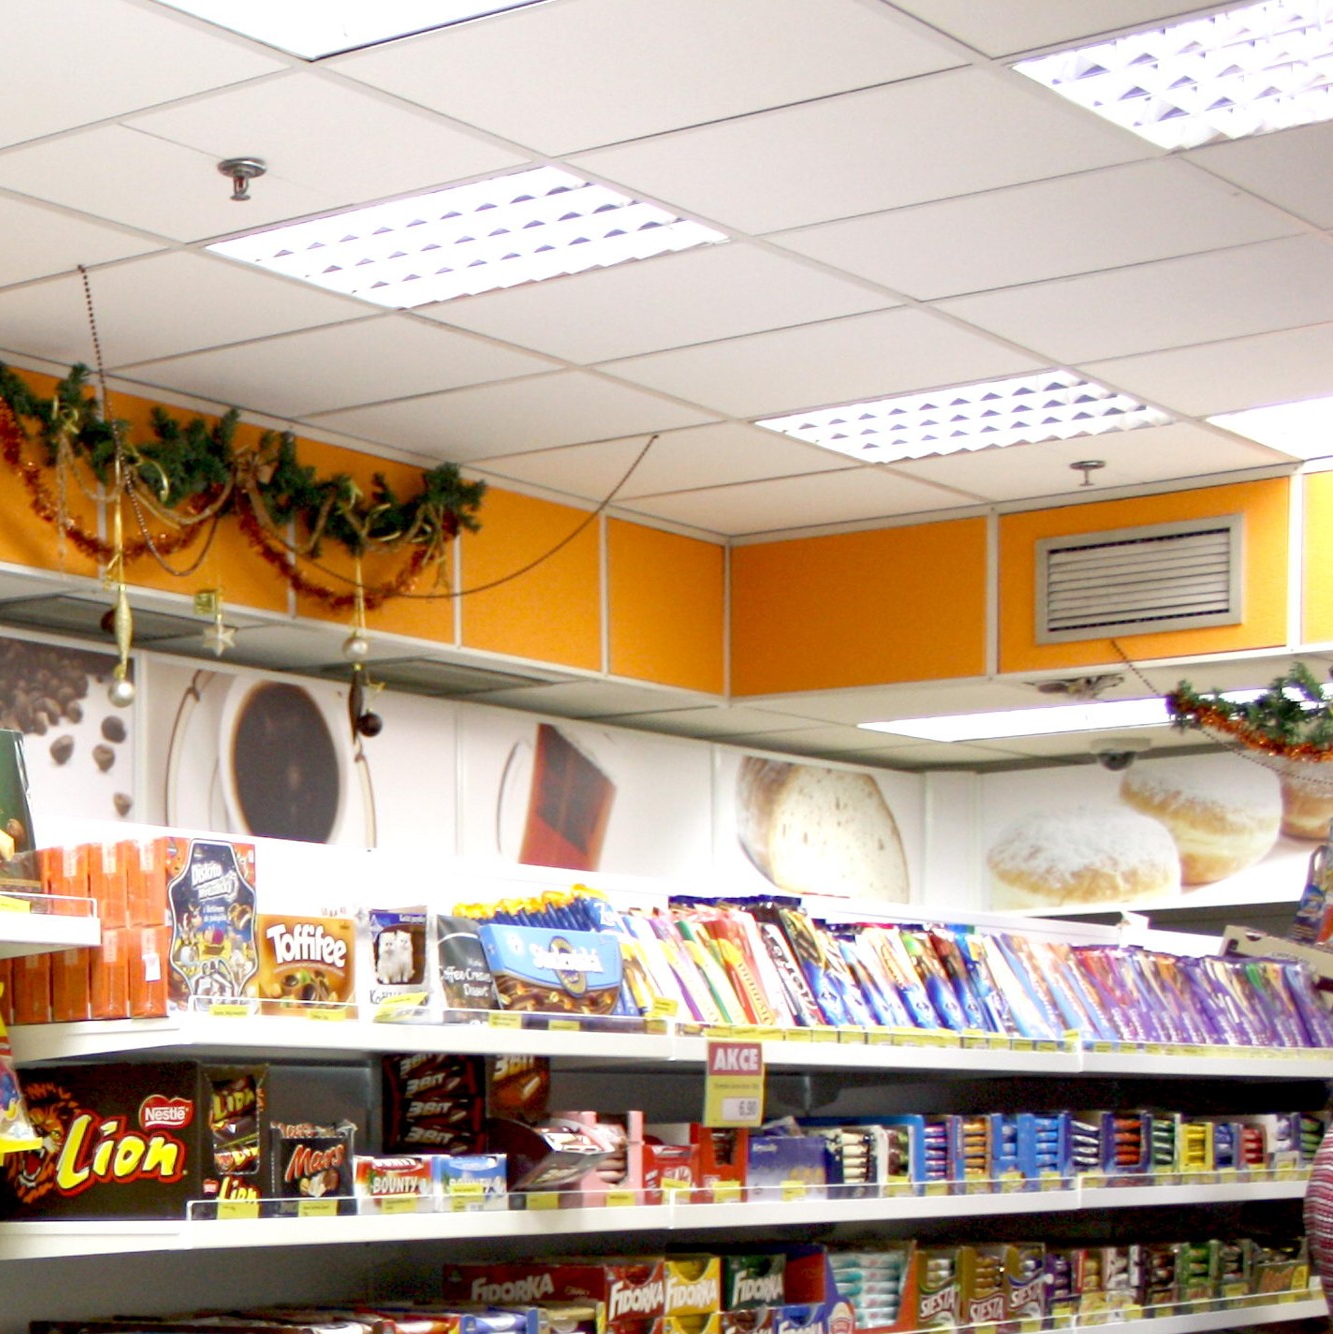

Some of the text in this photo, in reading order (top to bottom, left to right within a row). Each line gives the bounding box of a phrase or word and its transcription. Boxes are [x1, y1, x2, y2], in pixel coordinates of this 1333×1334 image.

[266, 923, 347, 968] Toffifee
[713, 1047, 760, 1074] AKCE
[144, 1104, 188, 1123] Nestlé
[55, 1112, 179, 1191] Lion
[284, 1142, 346, 1183] Mars
[373, 1175, 419, 1194] BOUNTY
[471, 1275, 555, 1300] FIDORKA
[609, 1279, 664, 1320] FIDORKA
[665, 1277, 718, 1316] FIDORKA
[734, 1273, 783, 1305] FIDORKA
[920, 1287, 957, 1322] SIESTA
[969, 1299, 1004, 1324] SIESTA
